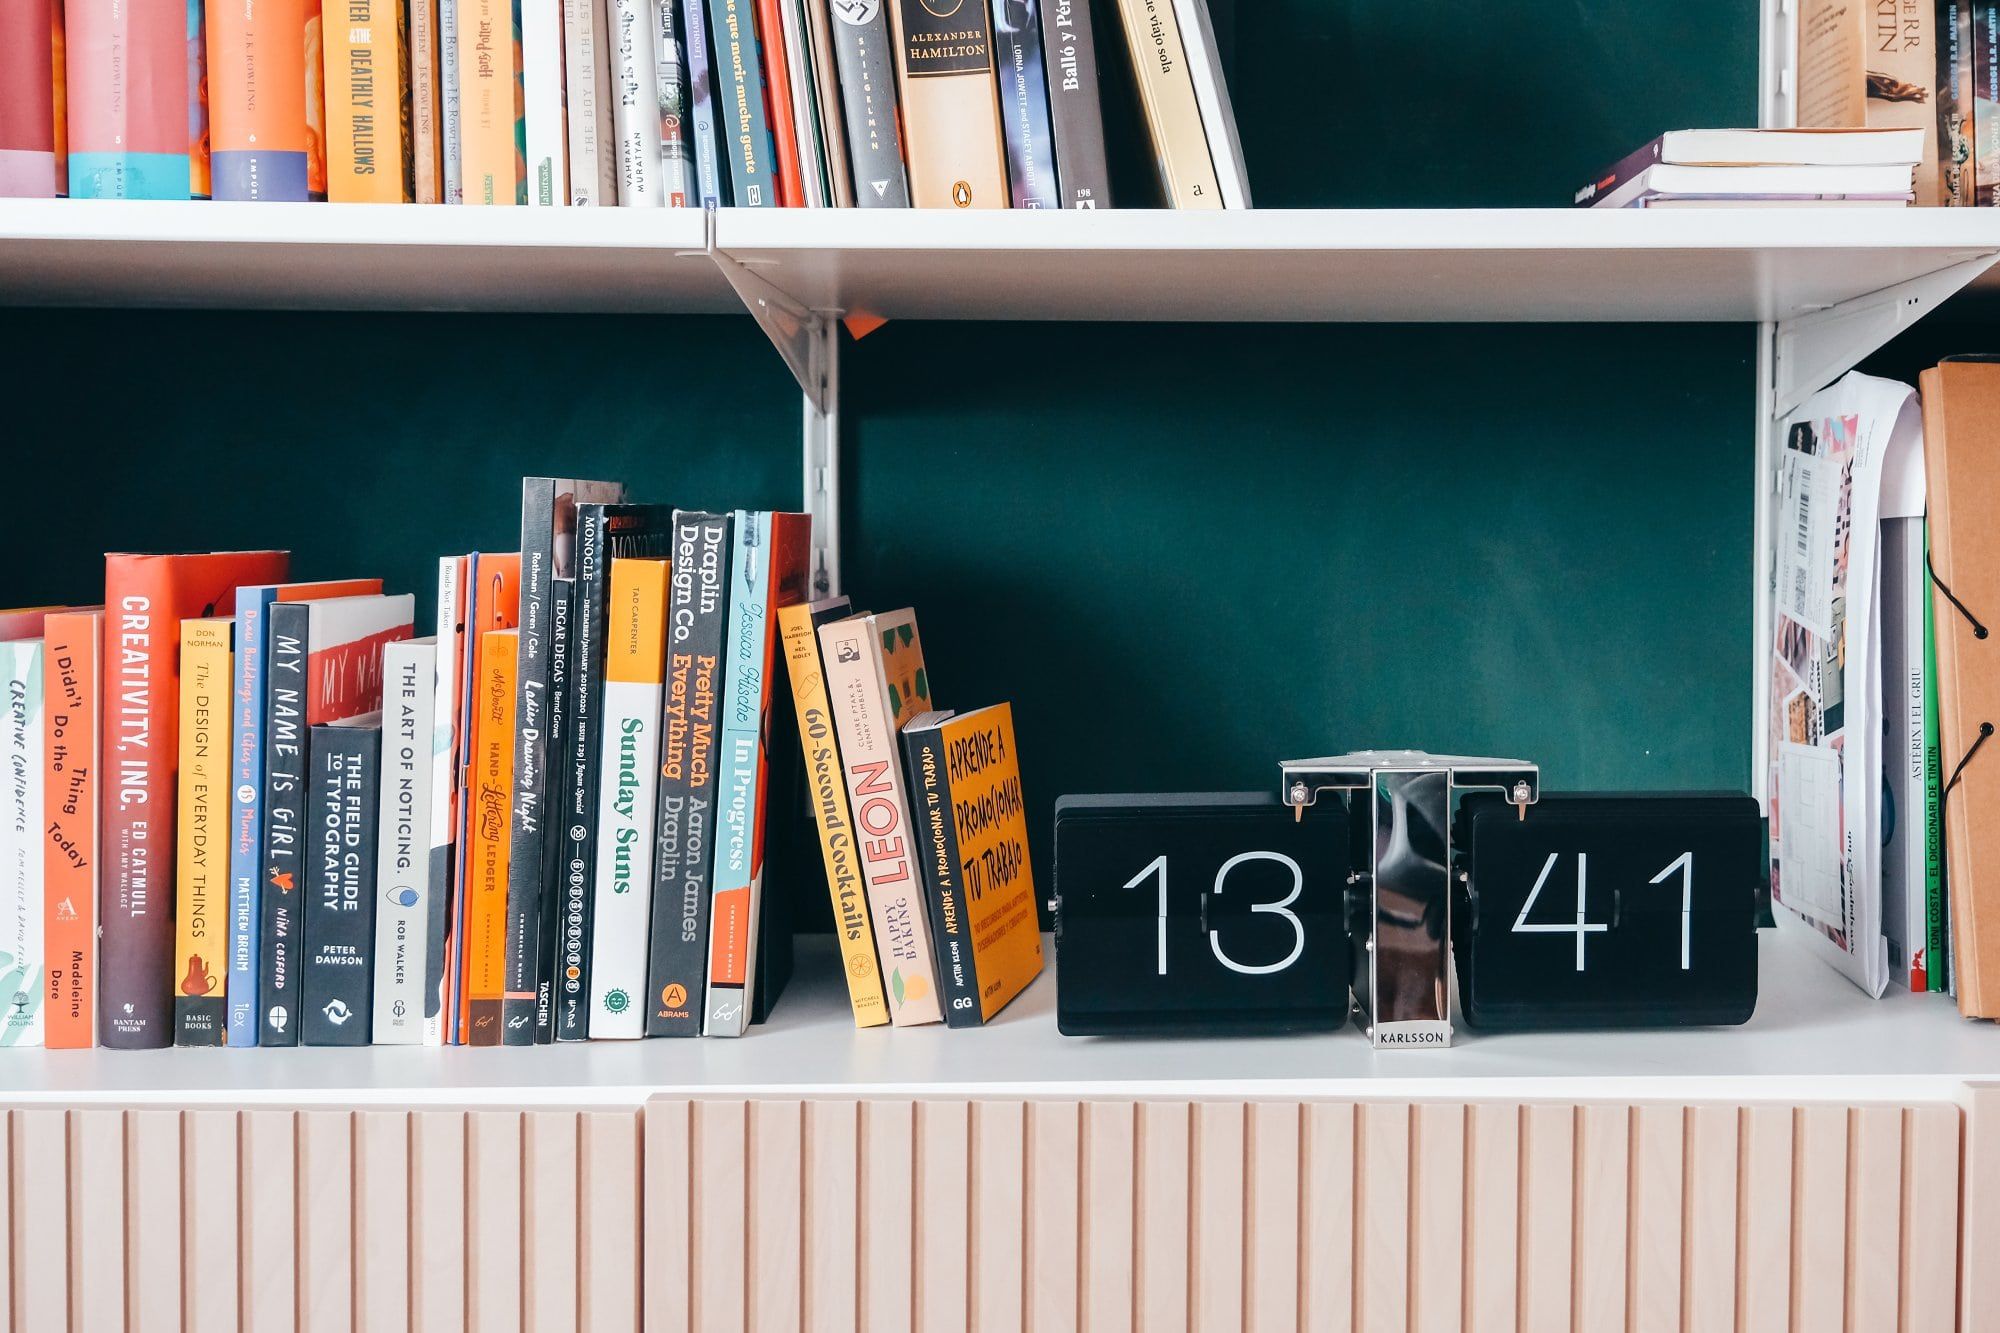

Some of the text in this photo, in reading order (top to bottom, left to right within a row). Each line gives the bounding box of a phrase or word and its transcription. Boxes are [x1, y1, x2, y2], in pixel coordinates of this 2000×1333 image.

[477, 20, 493, 78] Harry Potter
[582, 29, 590, 56] THE
[661, 6, 672, 35] Tanja
[911, 30, 982, 42] ALEXANDER
[1061, 32, 1076, 42] y
[1150, 15, 1172, 74] viajo sola
[1988, 7, 1997, 44] MARTIN
[351, 49, 374, 108] DEATHLY
[583, 65, 591, 80] IN
[910, 44, 985, 60] HAMILTON
[1013, 44, 1023, 72] LORNA
[1060, 46, 1079, 92] Balló
[583, 90, 592, 117] BOY
[622, 66, 639, 107] Paris
[726, 14, 755, 174] que morir mucha gente
[858, 37, 879, 150] SPIEGELMAN
[1016, 72, 1027, 108] JOWETT
[1989, 65, 1998, 103] GEORGE
[353, 115, 374, 174] HALLOWS
[634, 132, 645, 192] MURATYAN
[1021, 123, 1031, 153] STACEY
[1076, 188, 1091, 198] 198
[1193, 184, 1203, 197] a
[583, 516, 595, 581] MONOCLE
[699, 526, 722, 615] Draplin
[527, 552, 542, 659] Rothman Goren Cole
[673, 525, 698, 644] Design Co.
[187, 640, 224, 648] NORMAN
[630, 587, 640, 655] TAD CARPENTER
[739, 602, 763, 663] Jessica
[57, 656, 81, 708] Didn't
[276, 635, 300, 673] MY
[321, 648, 349, 710] MY
[552, 599, 567, 739] EDGAR DEGAS Bernd Growe
[117, 596, 150, 811] CREATIVITY, INC.
[274, 688, 298, 756] NAME
[578, 721, 586, 742] ISSUE
[662, 654, 692, 780] Everything
[690, 655, 716, 788] Pretty Much
[855, 677, 874, 751] HENRY DIMBLEBY
[9, 679, 27, 833] CREATIVE CONFIDENCE
[53, 715, 68, 772] Do the
[239, 610, 257, 856] Draw Buildings and Cities in 15 Minutes
[514, 680, 544, 833] Ladies Drawing Night
[576, 743, 586, 758] 129
[735, 738, 754, 762] In
[949, 724, 1006, 784] APRENDE A
[63, 768, 87, 815] Thing
[396, 663, 416, 875] THE ART OF NOTICING.
[575, 761, 586, 787] Japan
[921, 746, 937, 790] TRABAJO
[191, 662, 209, 938] The DESIGN of EVERYDAY THINGS
[575, 787, 585, 815] Special
[613, 718, 643, 894] Sunday Suns
[726, 767, 752, 871] Progress
[805, 708, 864, 941] 60-Second Cocktails
[851, 760, 910, 886] LEON
[927, 793, 939, 808] TU
[956, 776, 1022, 844] PROMOCIONAR
[47, 822, 87, 870] Today
[324, 752, 343, 912] TO TYPOGRAPHY
[343, 753, 361, 911] THE FIELD GUIDE
[661, 796, 683, 882] Draplin
[929, 807, 950, 876] PROMOCIONAR
[1927, 746, 1941, 951] TONI COSTA EL DICCIONARI DE TINTIN
[131, 821, 147, 918] ED CATMULL
[484, 844, 496, 892] LEDGER
[682, 796, 707, 942] Aaron James
[963, 840, 1022, 902] TU TRABAJO
[237, 877, 250, 971] MATTHEW BREHM
[884, 904, 904, 958] HAPPY
[895, 897, 917, 960] BAKING
[942, 889, 958, 934] APRENDE
[1122, 851, 1693, 976] 13 41
[275, 942, 285, 989] COSFORD
[315, 955, 363, 965] DAWSON
[323, 945, 356, 954] PETER
[395, 920, 405, 985] ROB WALKER
[949, 941, 961, 963] KLEON
[51, 969, 62, 1000] Dore
[72, 951, 83, 1018] Madeleine
[538, 981, 550, 1026] TASCHEN
[953, 997, 972, 1009] GG
[184, 1022, 212, 1030] BOOKS
[234, 1003, 249, 1027] ilex
[658, 1010, 689, 1018] ABRAMS
[1380, 1033, 1444, 1043] KARLSSON
